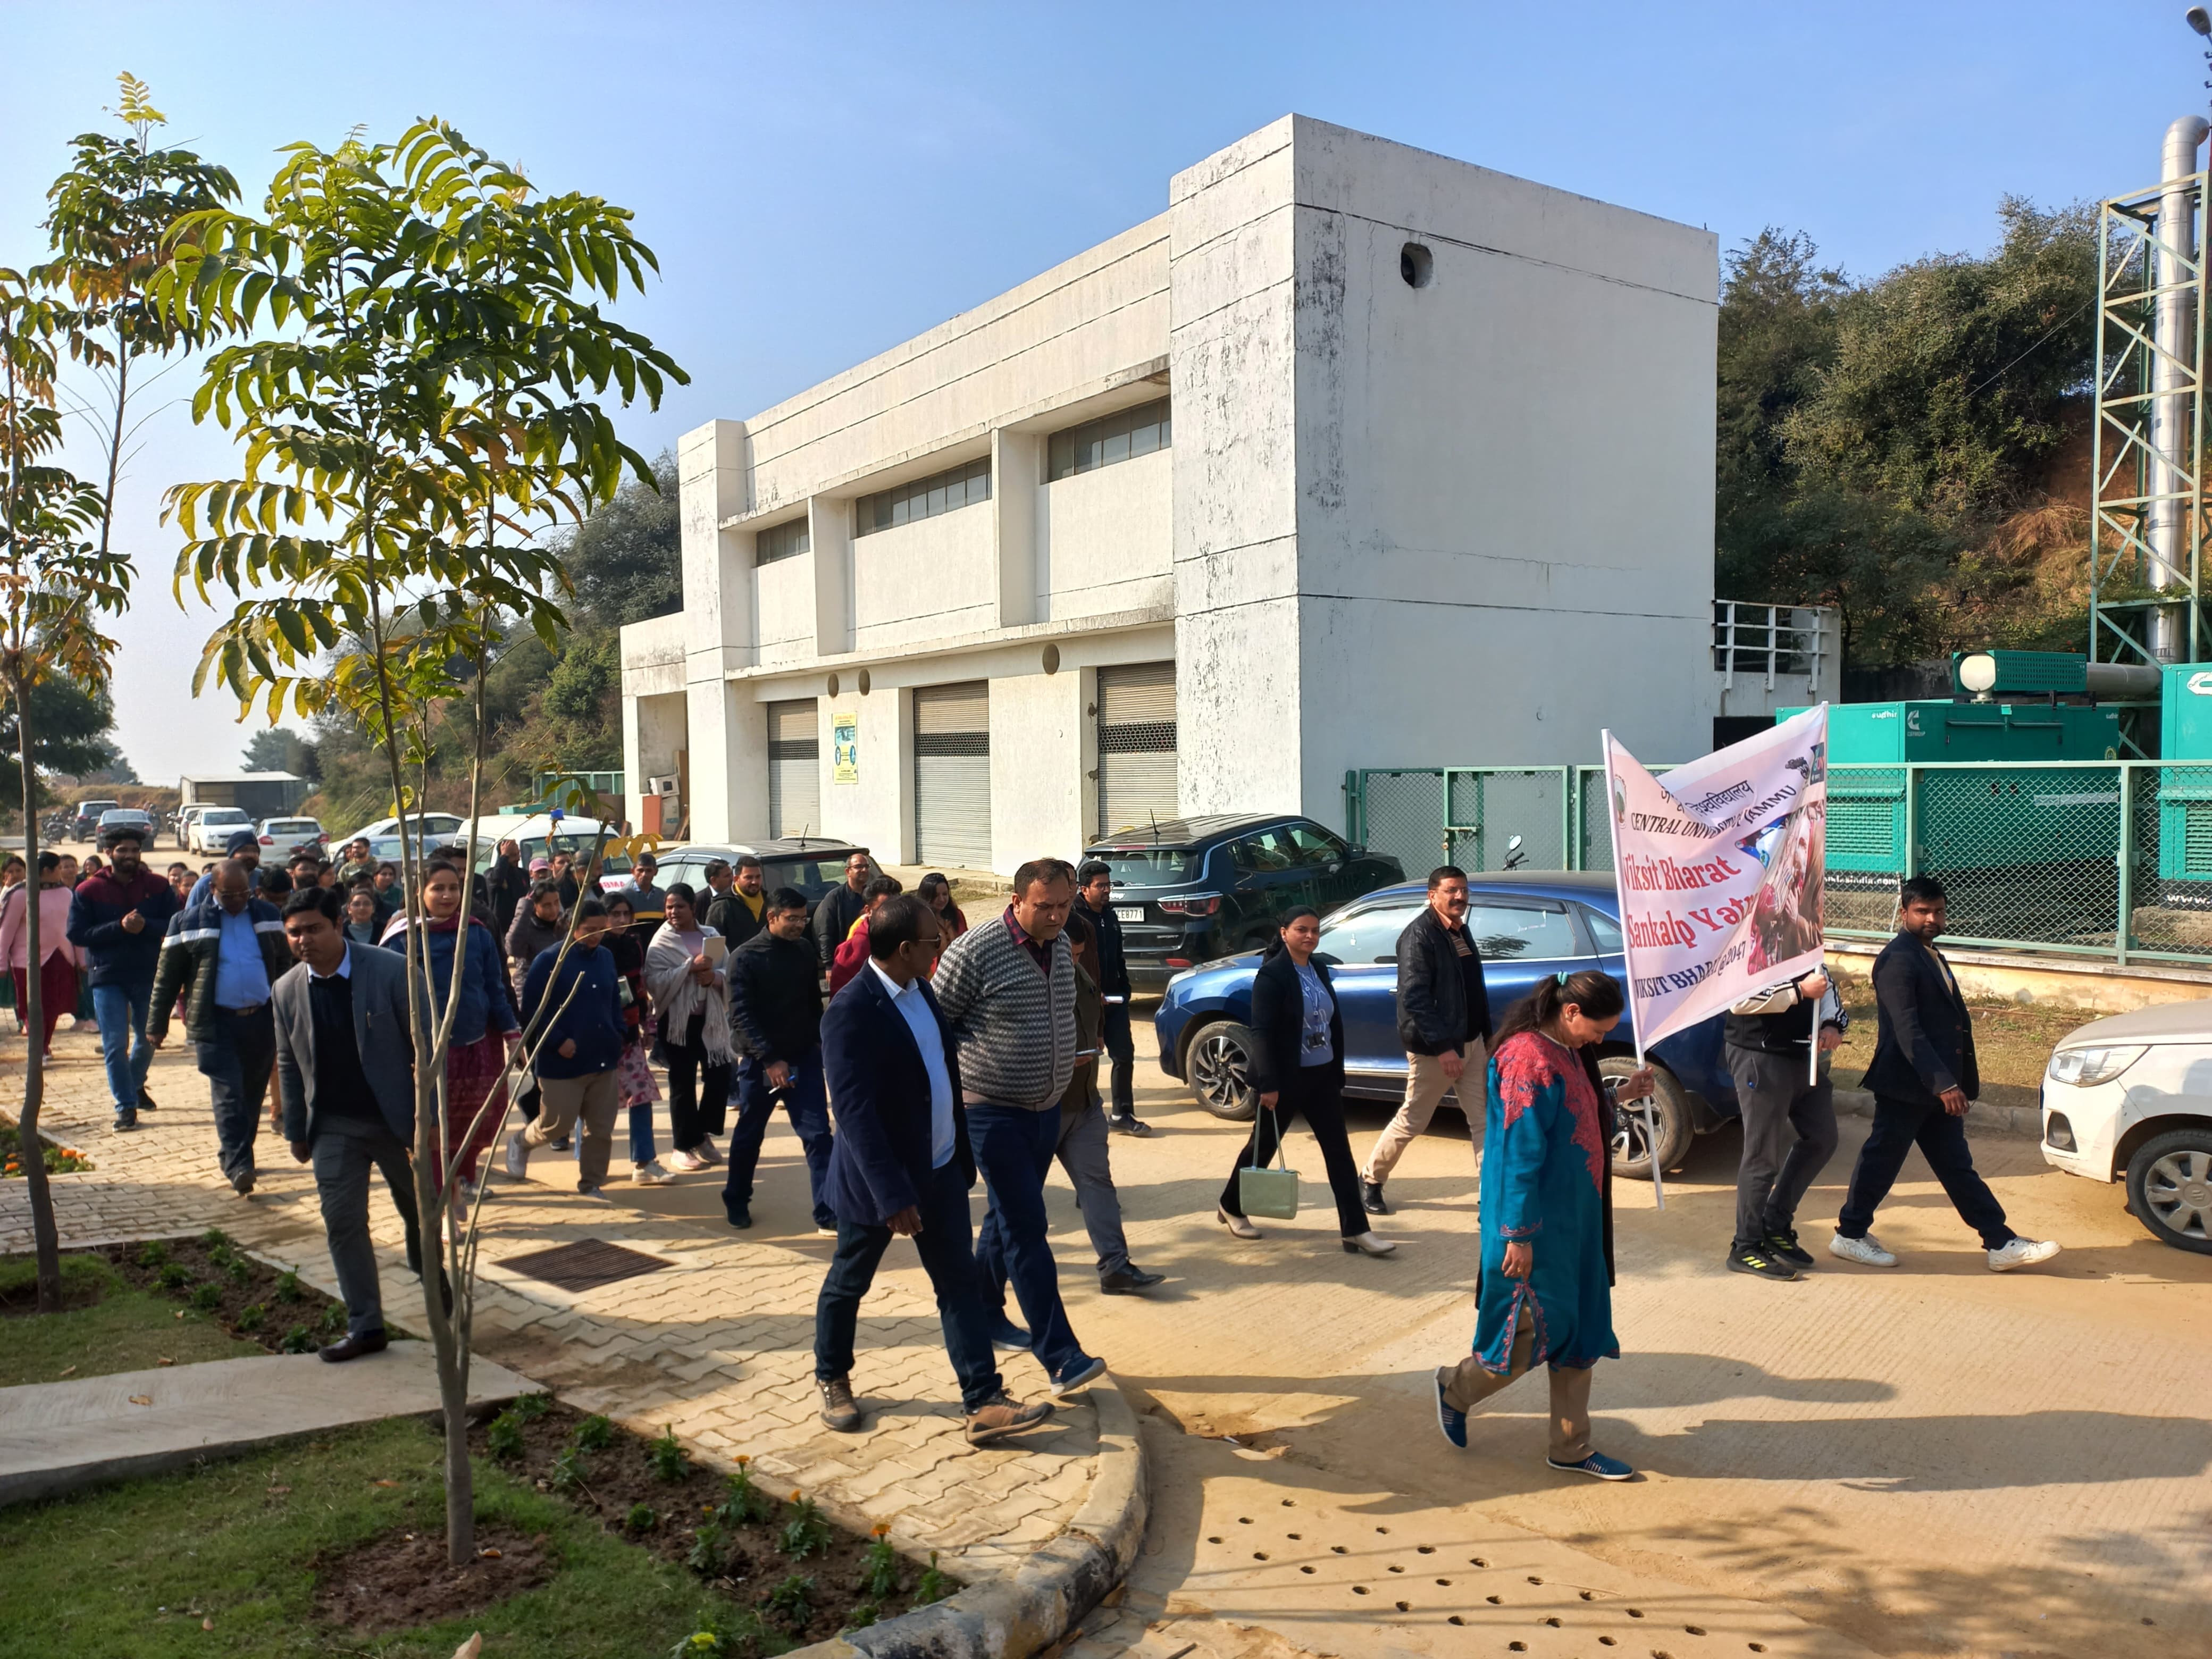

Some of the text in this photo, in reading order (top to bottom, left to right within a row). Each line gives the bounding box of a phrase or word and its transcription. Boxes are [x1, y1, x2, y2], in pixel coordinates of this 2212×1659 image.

[1631, 812, 1682, 835] CENTRAL
[1623, 853, 1741, 891] Viksit Bharat
[1627, 893, 1758, 949] Sankalp Yatr
